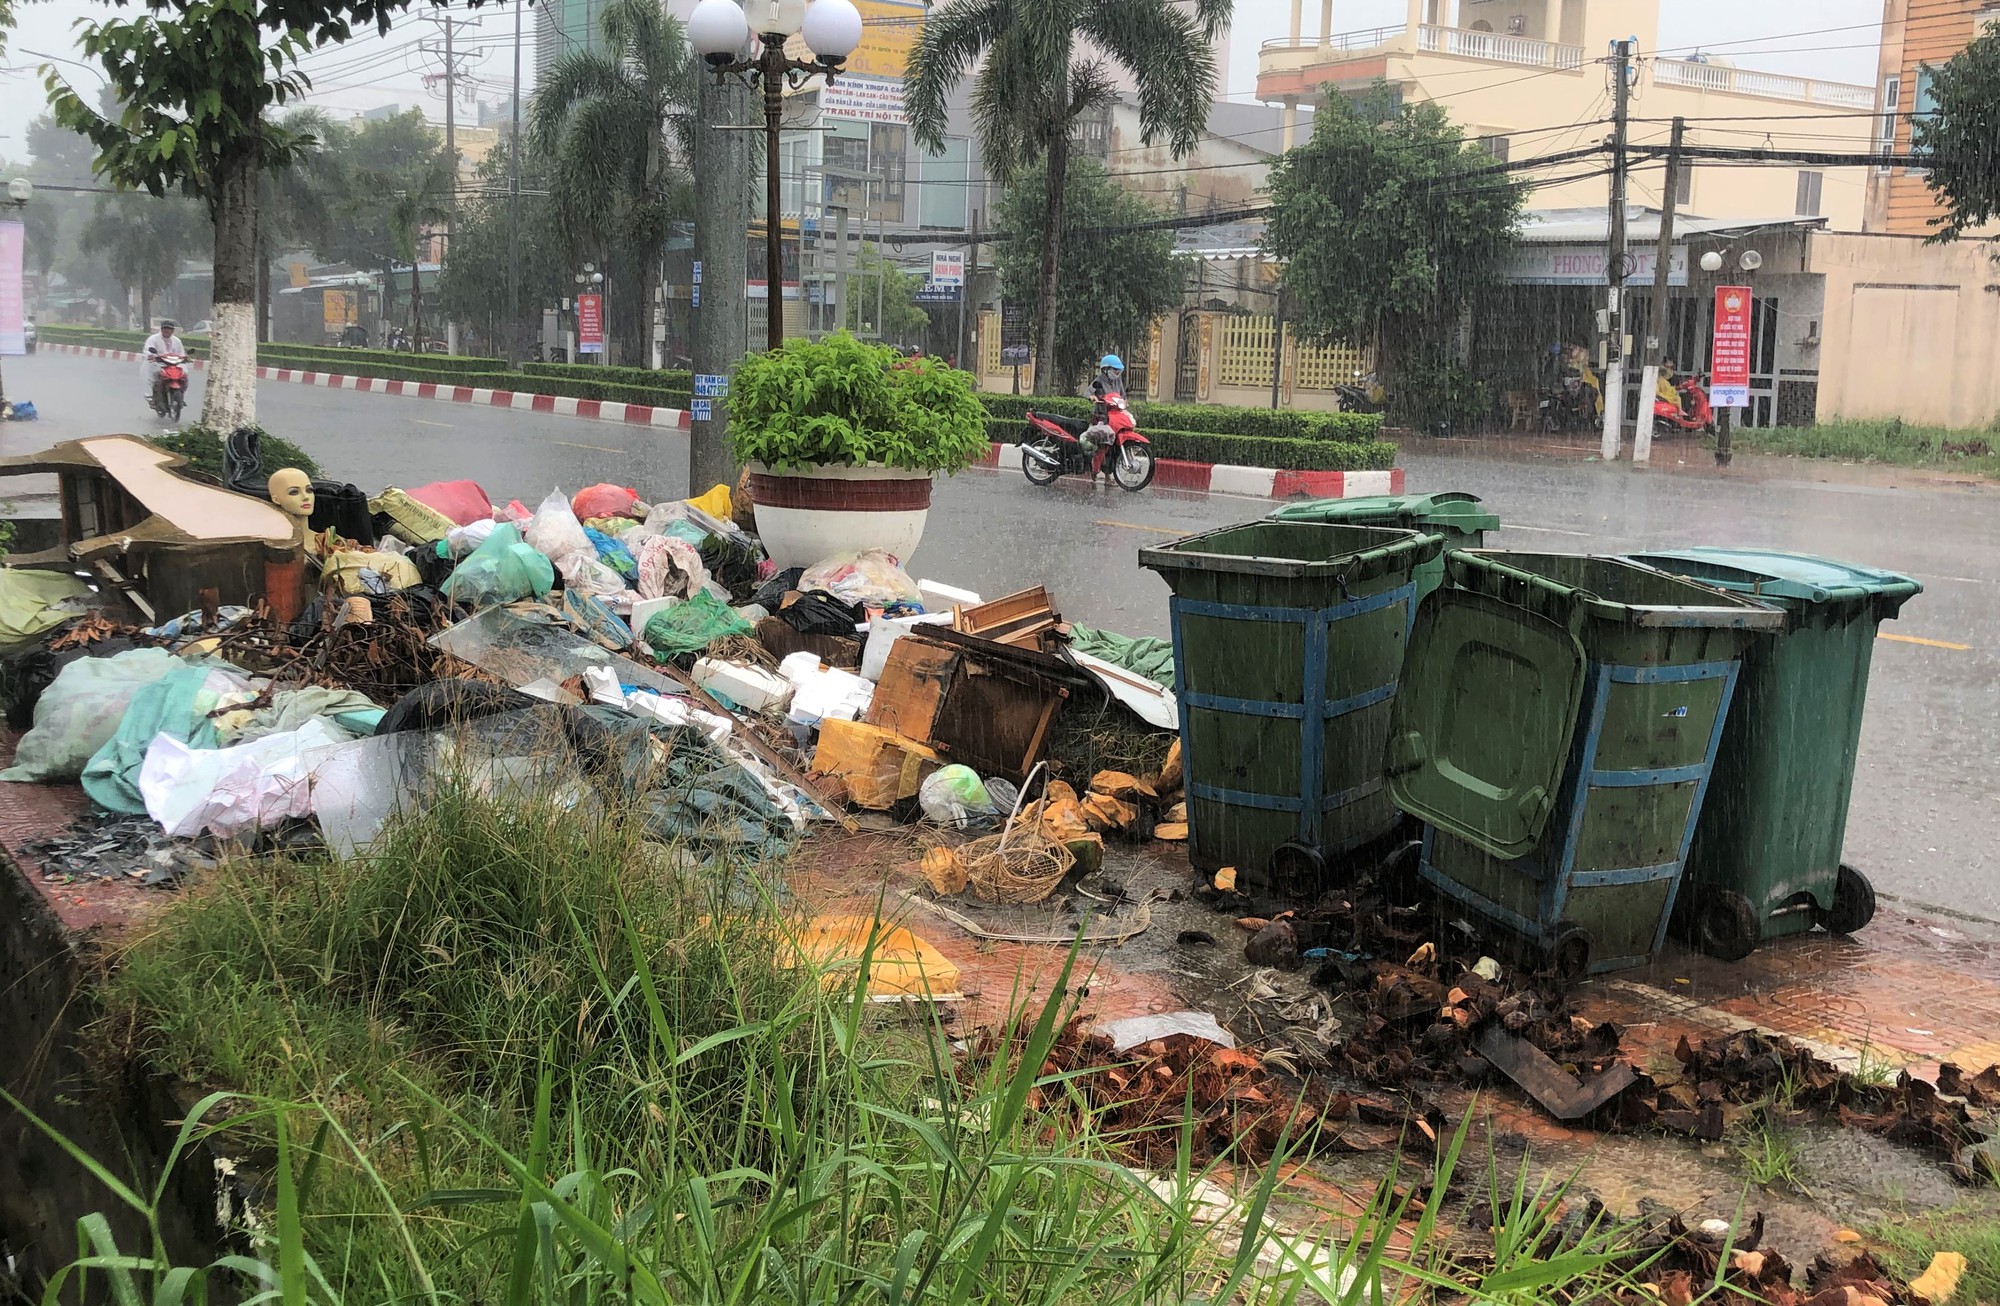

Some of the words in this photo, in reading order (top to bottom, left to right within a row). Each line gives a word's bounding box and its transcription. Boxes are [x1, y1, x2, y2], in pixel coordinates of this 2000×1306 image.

[865, 83, 888, 92] XINGFA
[825, 107, 856, 116] TRANG
[859, 110, 874, 118] TRÍ
[876, 111, 891, 121] NỘI
[1553, 255, 1602, 274] PHONG
